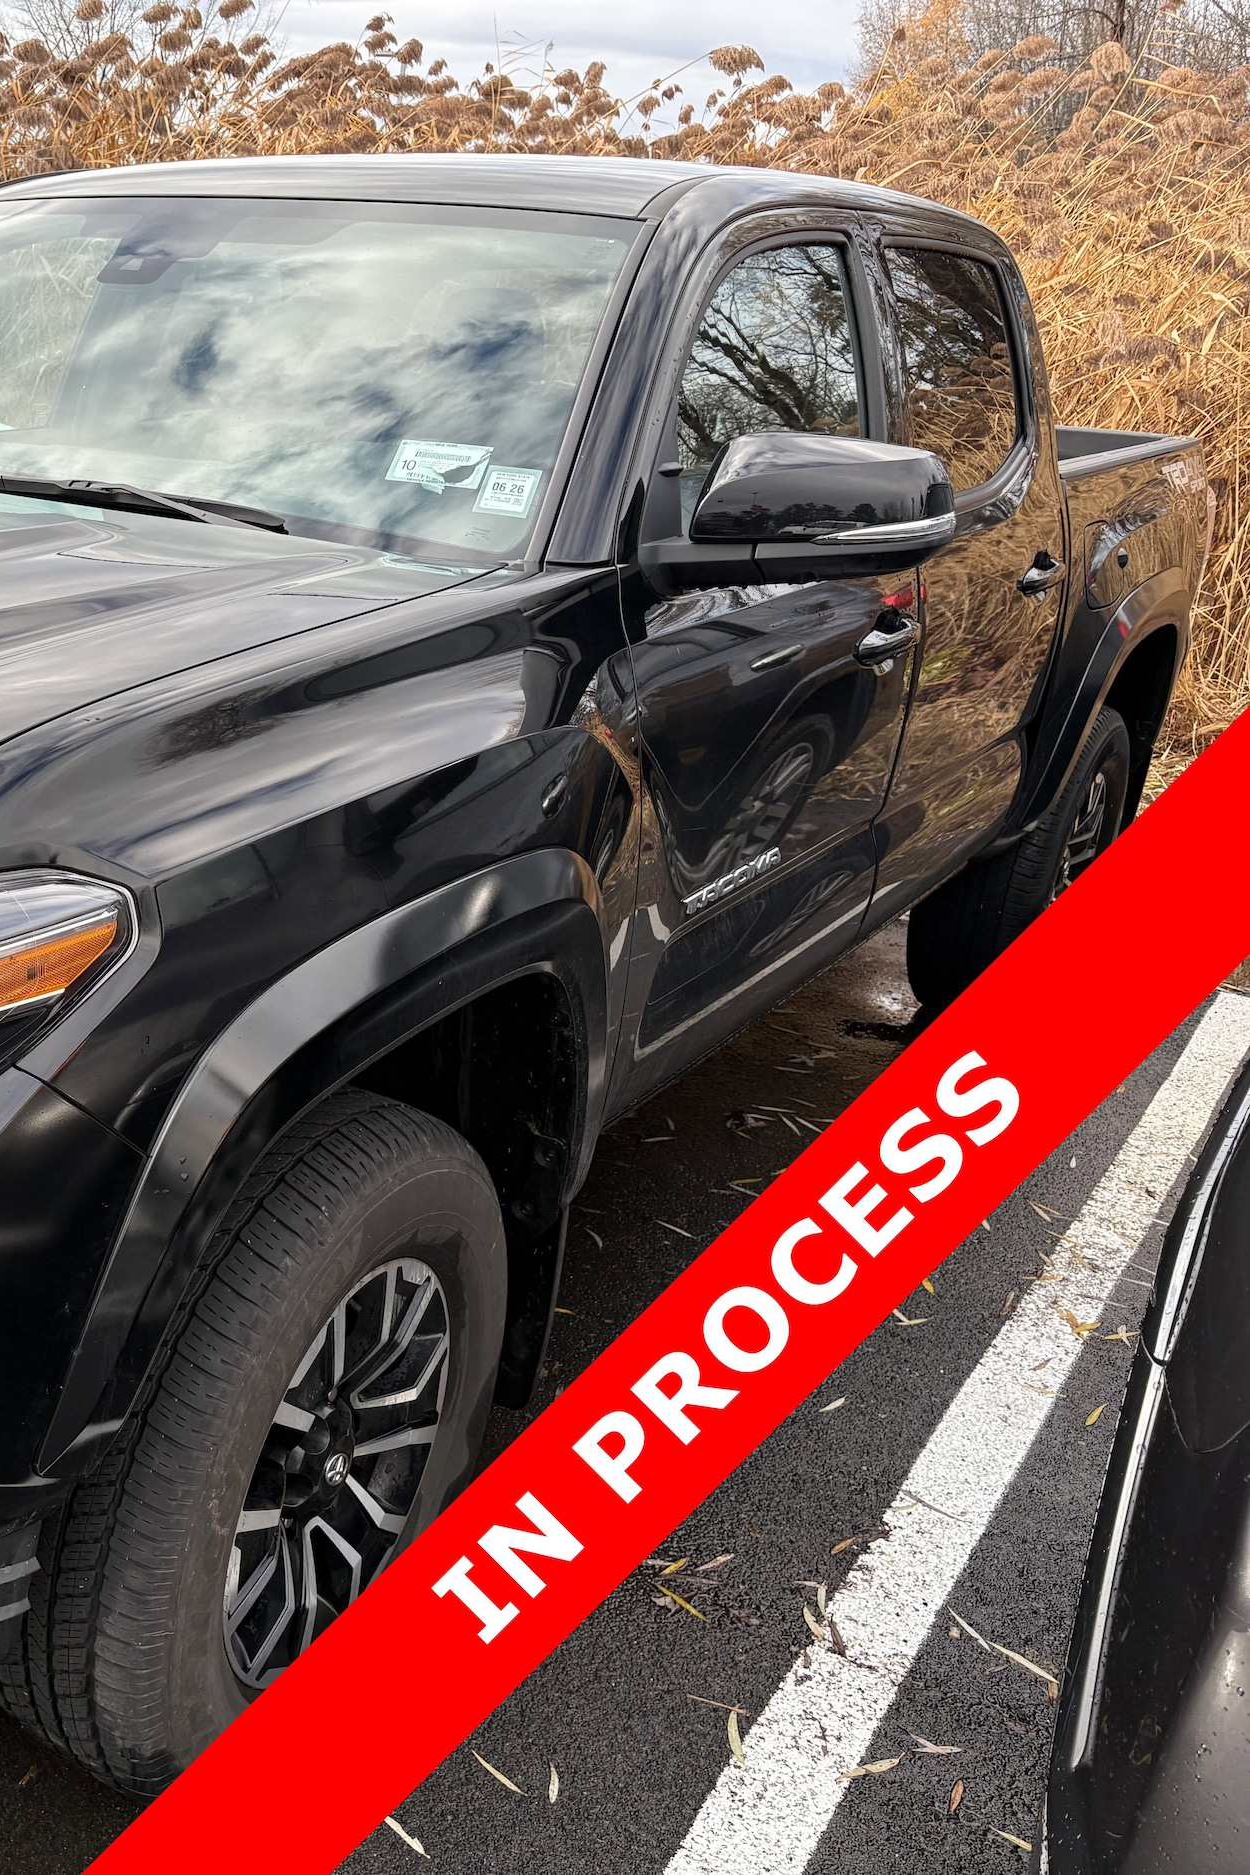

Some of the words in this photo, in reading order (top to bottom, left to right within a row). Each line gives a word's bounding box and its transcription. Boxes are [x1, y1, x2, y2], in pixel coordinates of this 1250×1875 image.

[401, 459, 417, 471] 10
[492, 482, 507, 492] 06
[510, 484, 525, 494] 26
[1161, 461, 1189, 494] TRD
[681, 847, 781, 914] TACOMA
